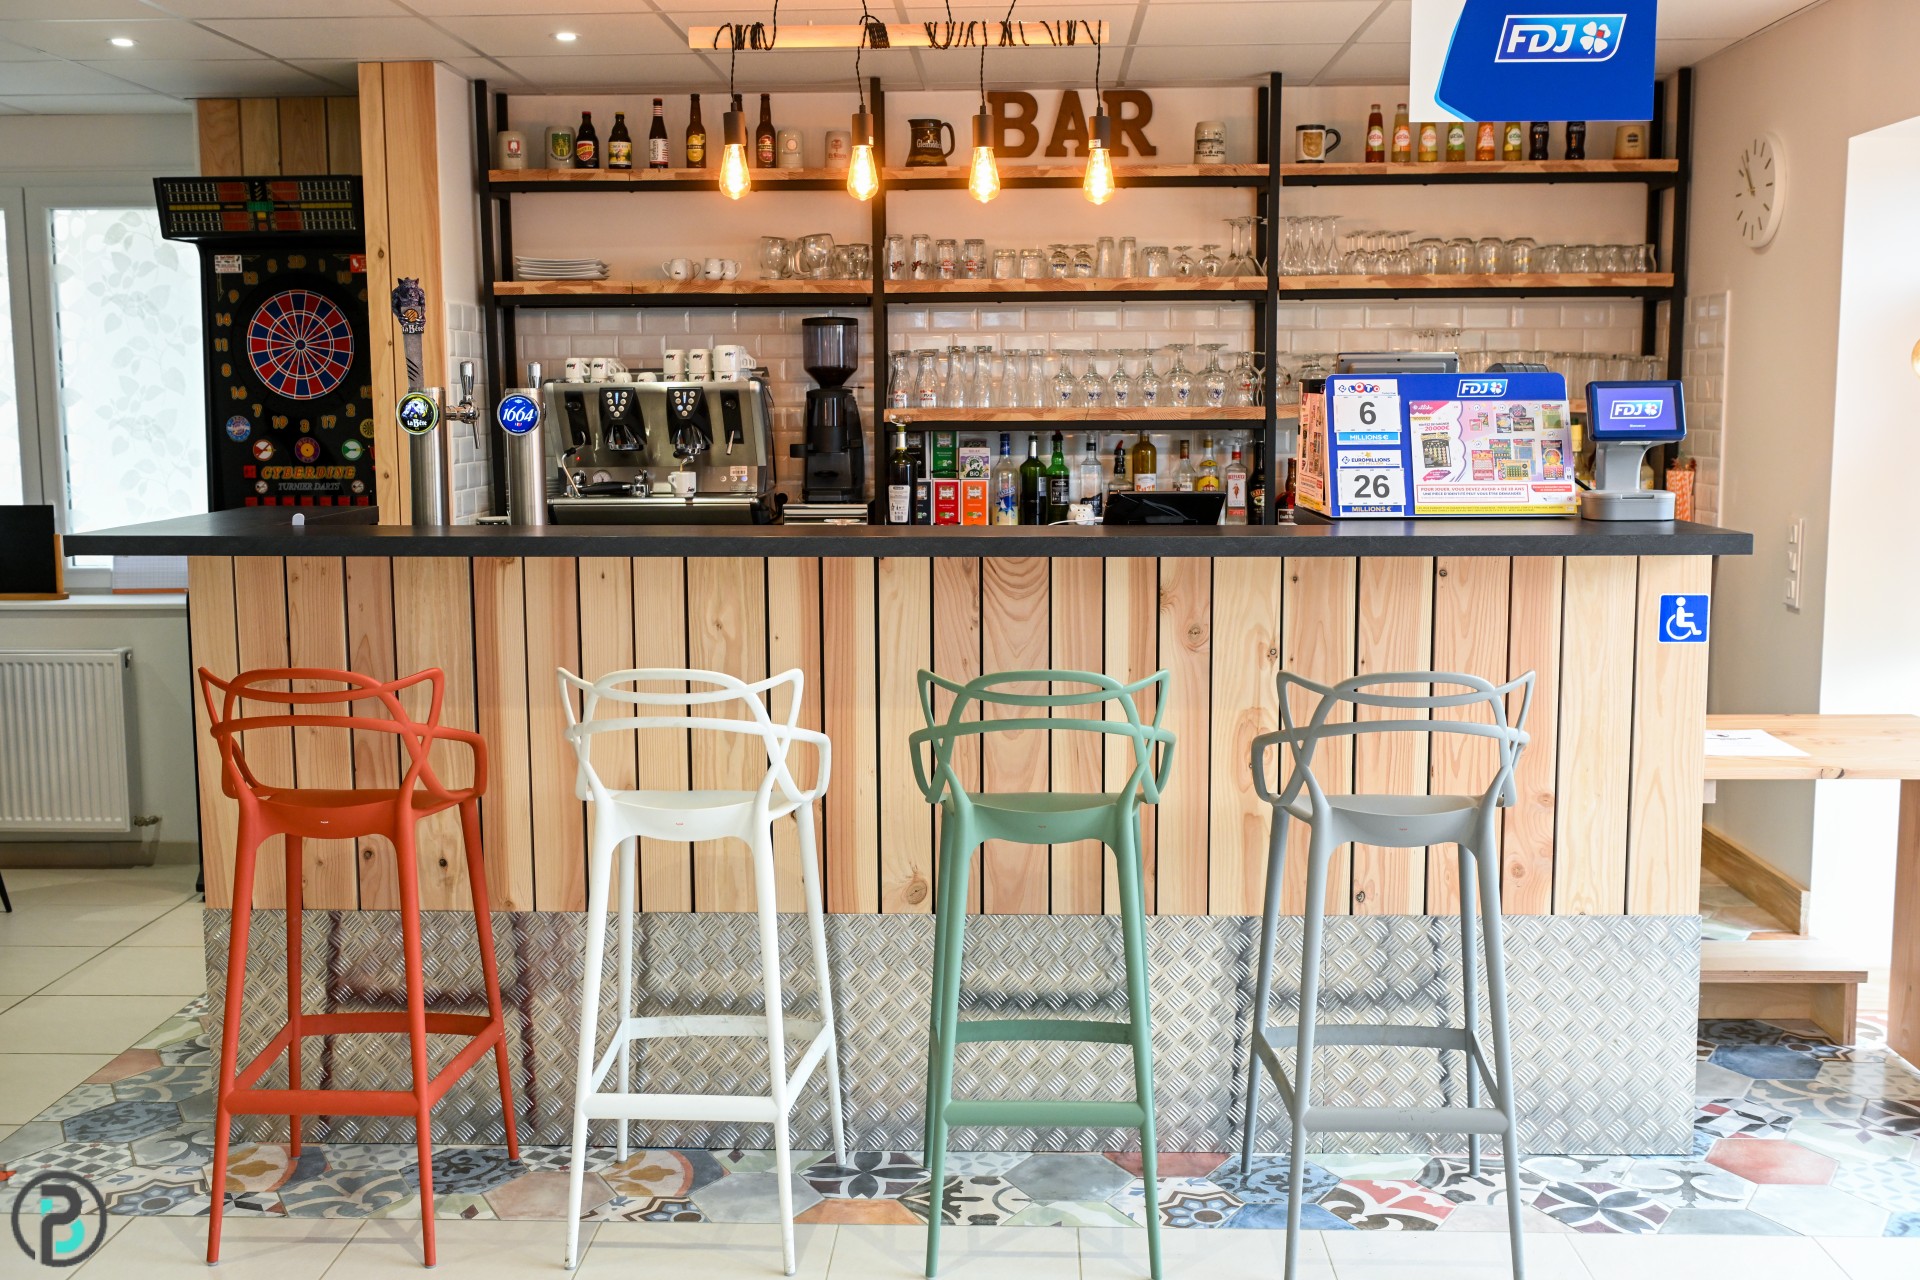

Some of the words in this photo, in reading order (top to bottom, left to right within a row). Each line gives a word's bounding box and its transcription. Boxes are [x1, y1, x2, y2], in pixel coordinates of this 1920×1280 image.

[1506, 24, 1577, 53] FDJ
[987, 89, 1157, 158] BAR
[215, 312, 232, 326] 14
[214, 338, 228, 352] 11
[231, 386, 247, 400] 16
[1348, 382, 1380, 394] LOTO
[1461, 382, 1488, 395] FDJ
[252, 403, 263, 418] 7
[502, 406, 535, 422] 1664
[1359, 401, 1377, 425] 6
[1614, 403, 1643, 416] FDJ
[321, 415, 337, 429] 17
[261, 466, 356, 479] CYBERDINE
[278, 482, 312, 491] TURNIER
[313, 482, 340, 490] DARTS
[1354, 475, 1390, 498] 26
